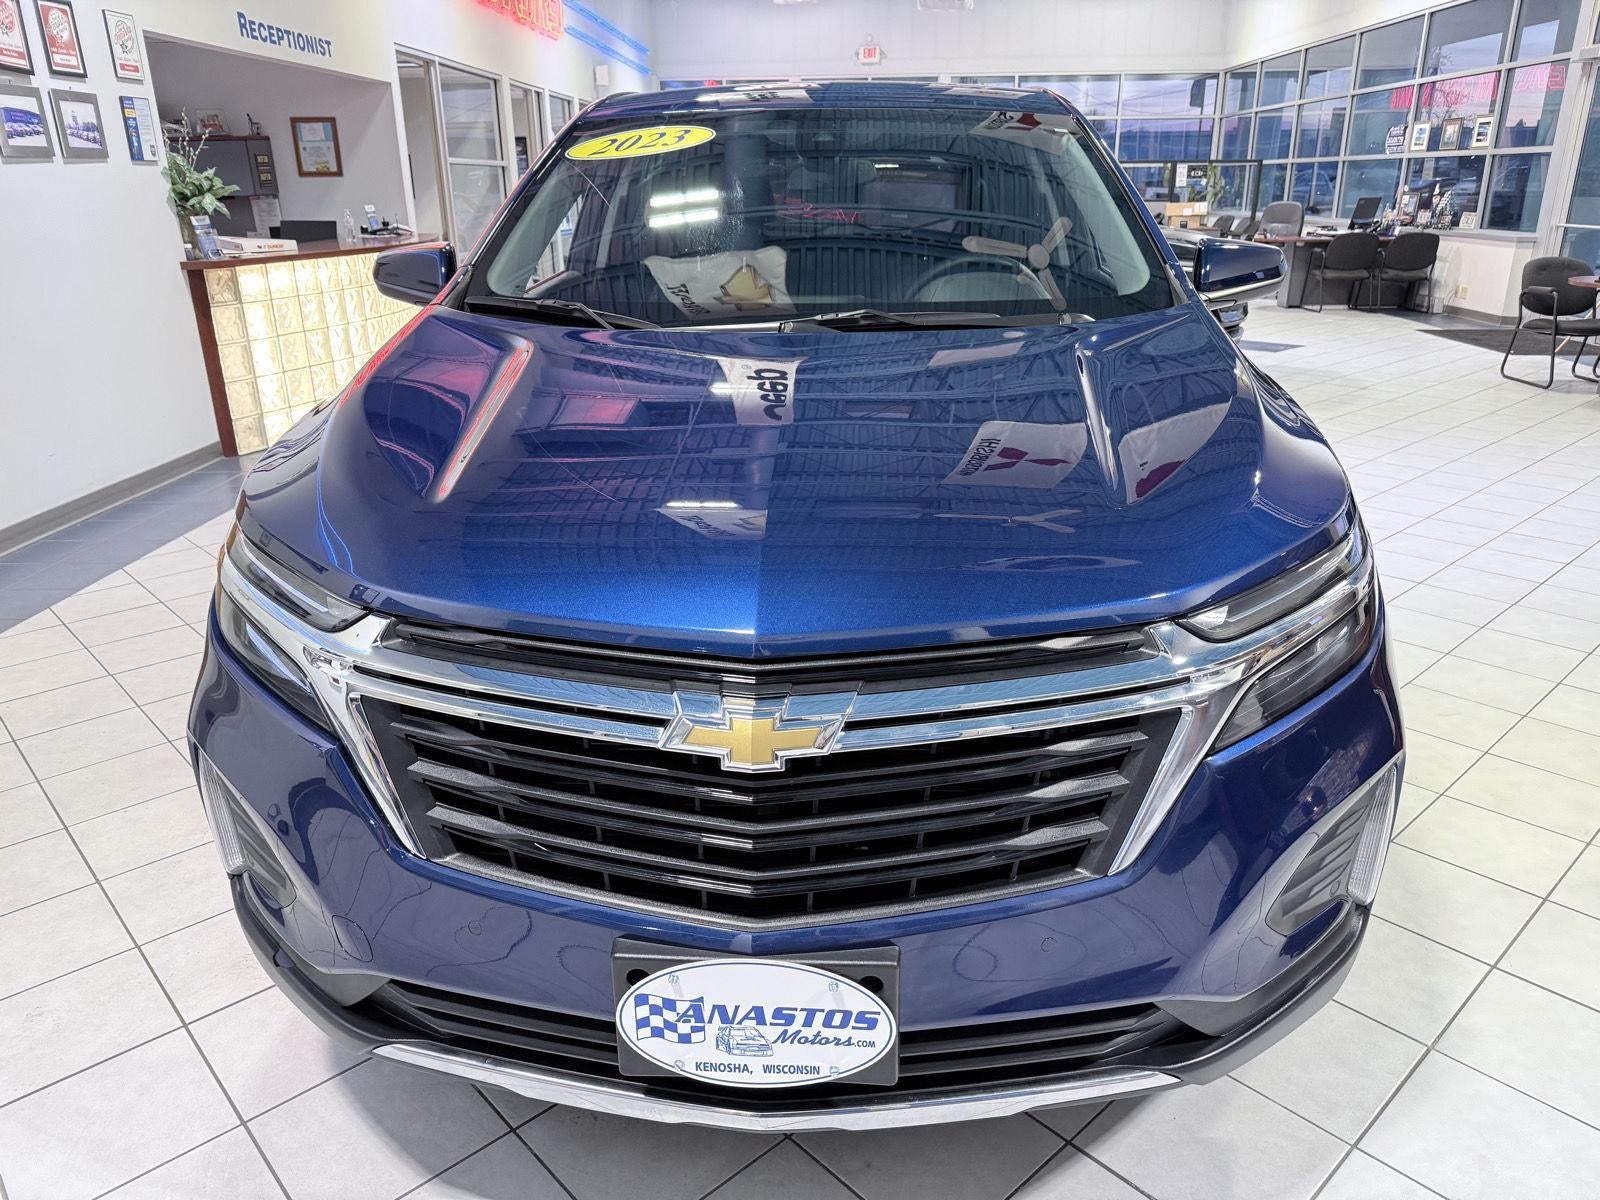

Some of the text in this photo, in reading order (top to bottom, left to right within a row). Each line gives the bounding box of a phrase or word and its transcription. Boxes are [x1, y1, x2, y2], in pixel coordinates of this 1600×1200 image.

[863, 47, 877, 59] EXIT
[587, 129, 692, 157] 2023
[674, 1003, 881, 1031] ANASTOS
[695, 1060, 820, 1076] KENOSHA, WISCONSIN
